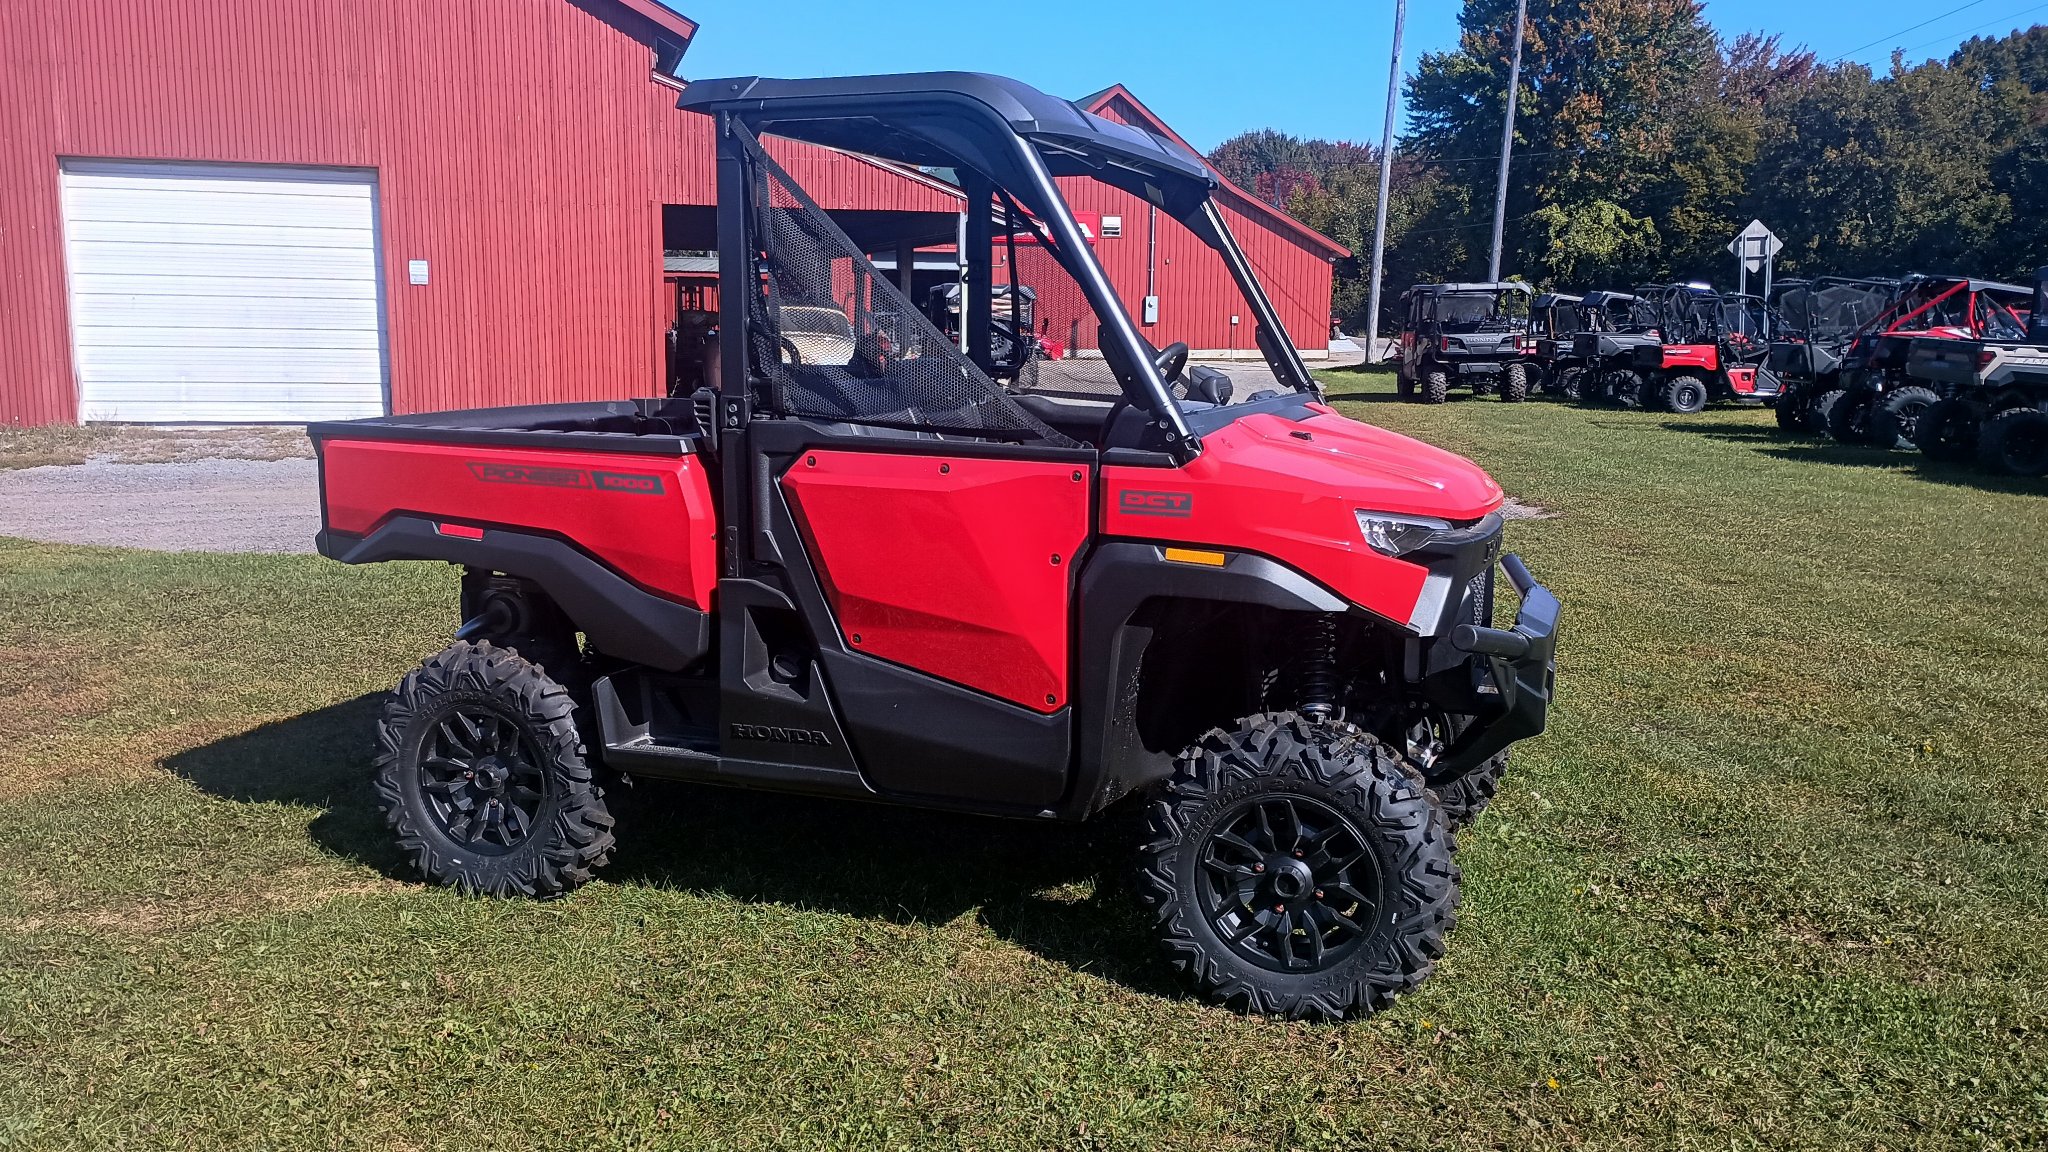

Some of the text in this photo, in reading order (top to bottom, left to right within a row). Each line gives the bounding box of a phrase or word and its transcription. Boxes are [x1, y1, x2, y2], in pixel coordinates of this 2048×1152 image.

[603, 476, 654, 491] 1000
[1124, 494, 1187, 508] DCT
[731, 723, 832, 746] HONDA
